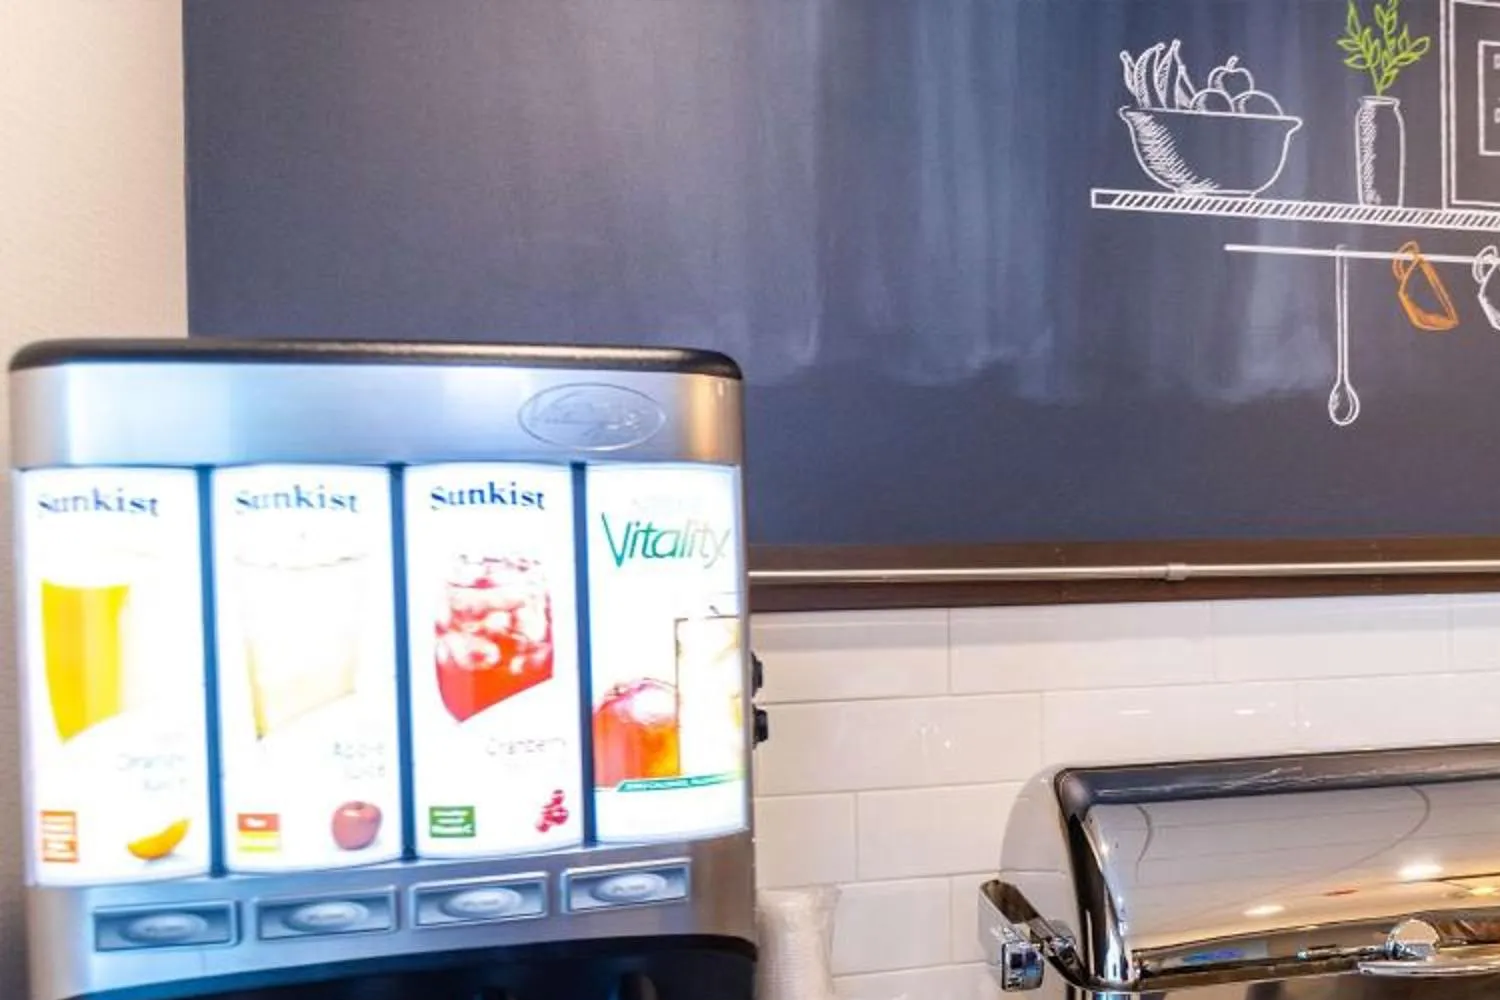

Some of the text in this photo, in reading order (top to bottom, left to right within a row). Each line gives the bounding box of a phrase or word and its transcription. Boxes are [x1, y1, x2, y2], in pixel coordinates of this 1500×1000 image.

[38, 487, 158, 518] Sunkist
[236, 483, 358, 515] Sunkist
[430, 481, 545, 511] Sunkist
[601, 508, 730, 569] Vitality
